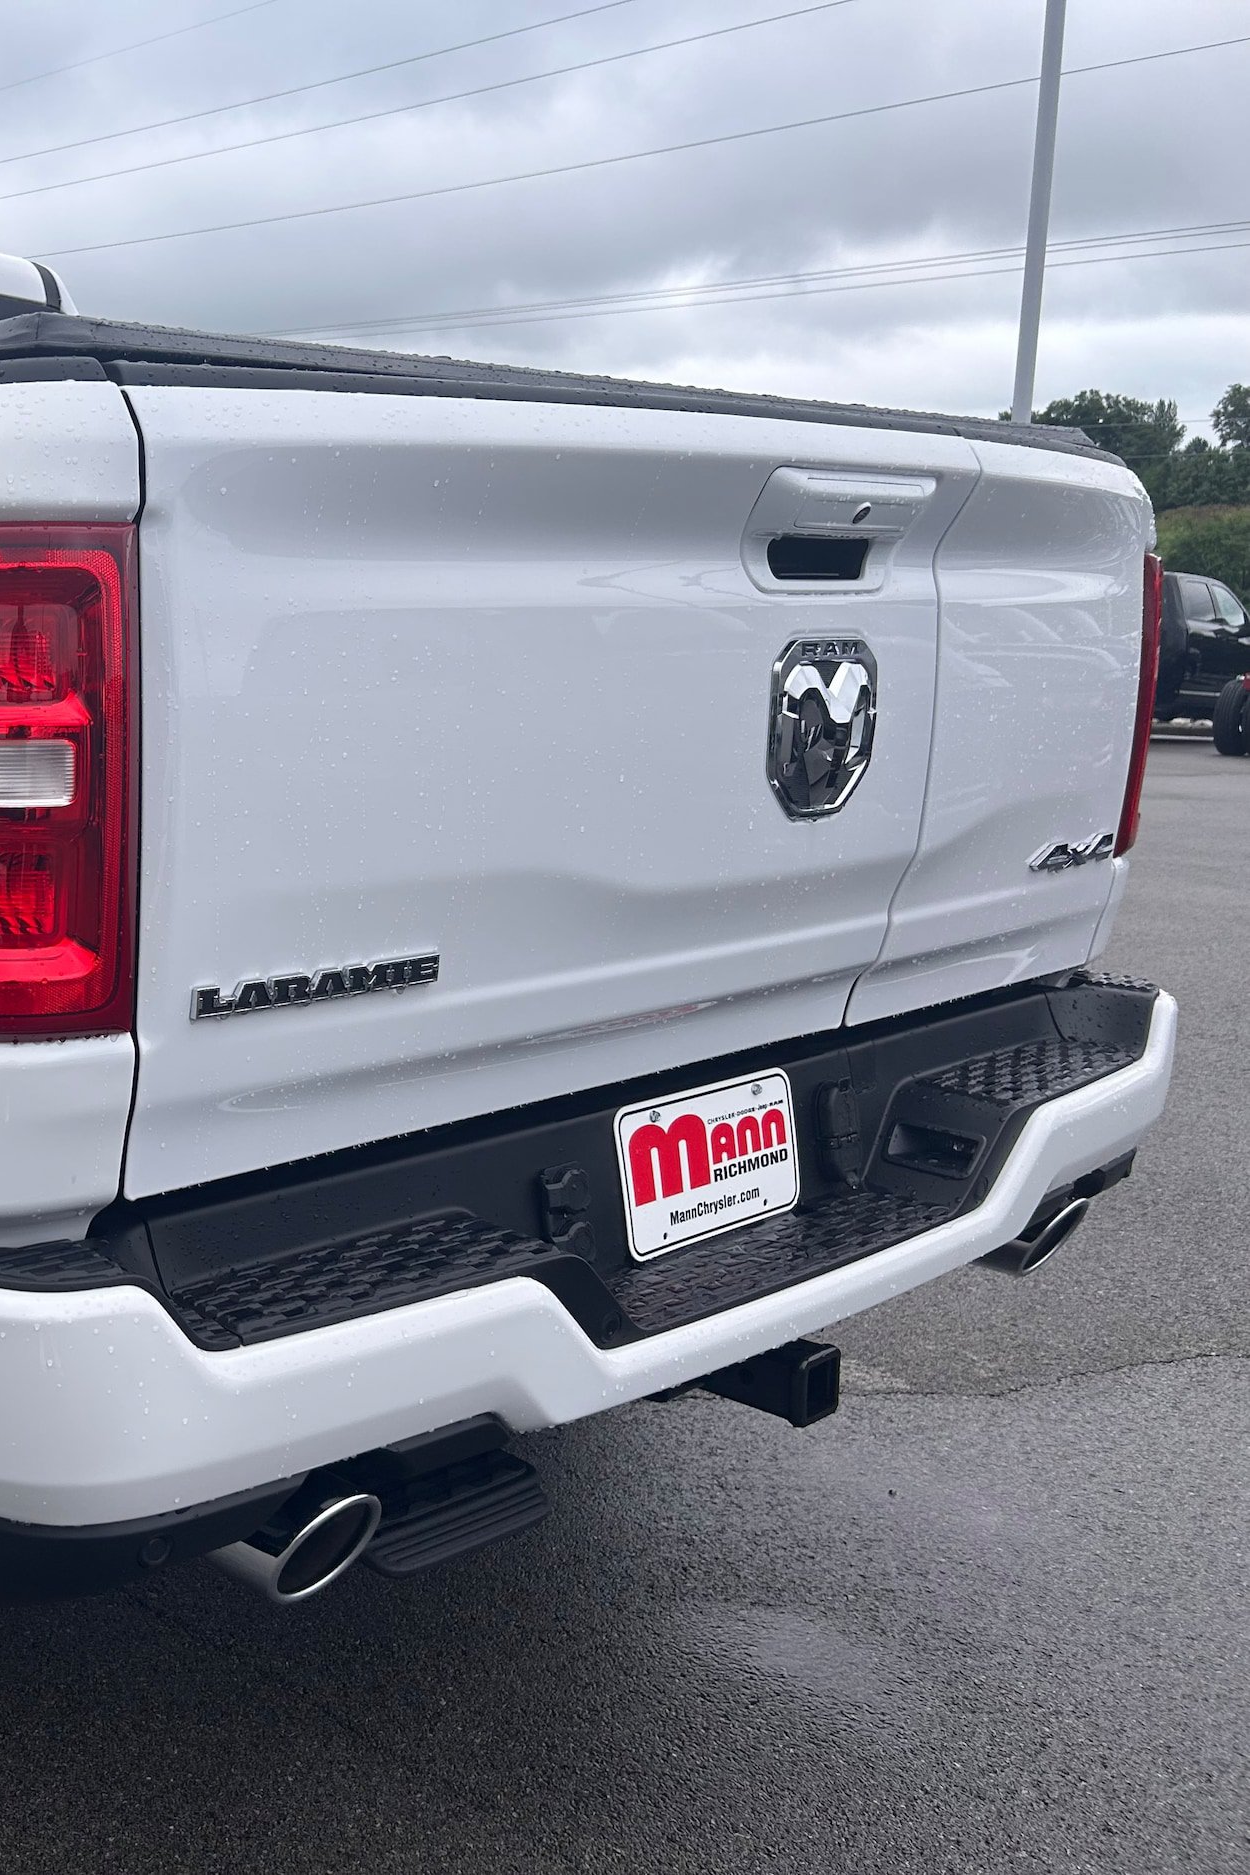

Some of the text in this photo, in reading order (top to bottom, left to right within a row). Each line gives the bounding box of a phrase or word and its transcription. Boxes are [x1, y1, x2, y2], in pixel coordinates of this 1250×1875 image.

[801, 641, 860, 657] RAM
[190, 952, 440, 1022] LARAMIE
[713, 1148, 788, 1183] RICHMOND
[670, 1187, 760, 1226] MannChrysler.com
